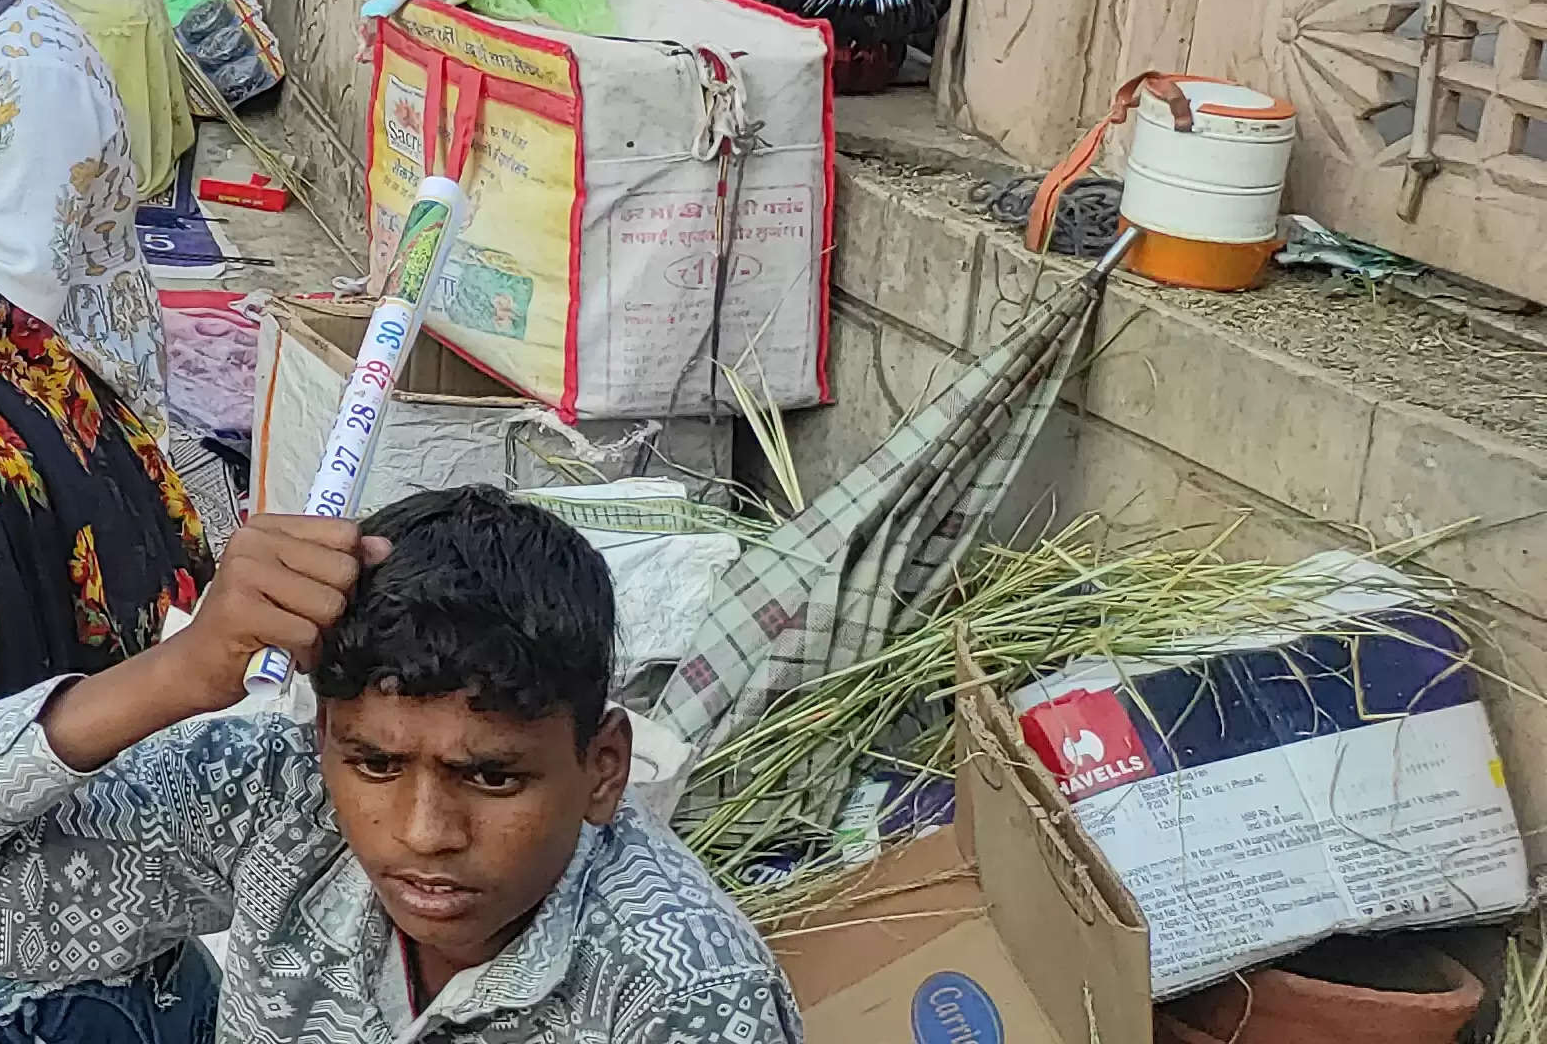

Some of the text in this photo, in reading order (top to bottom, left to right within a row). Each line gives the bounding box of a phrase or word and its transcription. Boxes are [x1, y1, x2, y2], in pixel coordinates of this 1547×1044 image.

[376, 320, 406, 350] 30
[362, 360, 392, 391] 29
[347, 403, 376, 436] 28
[331, 445, 361, 478] 27
